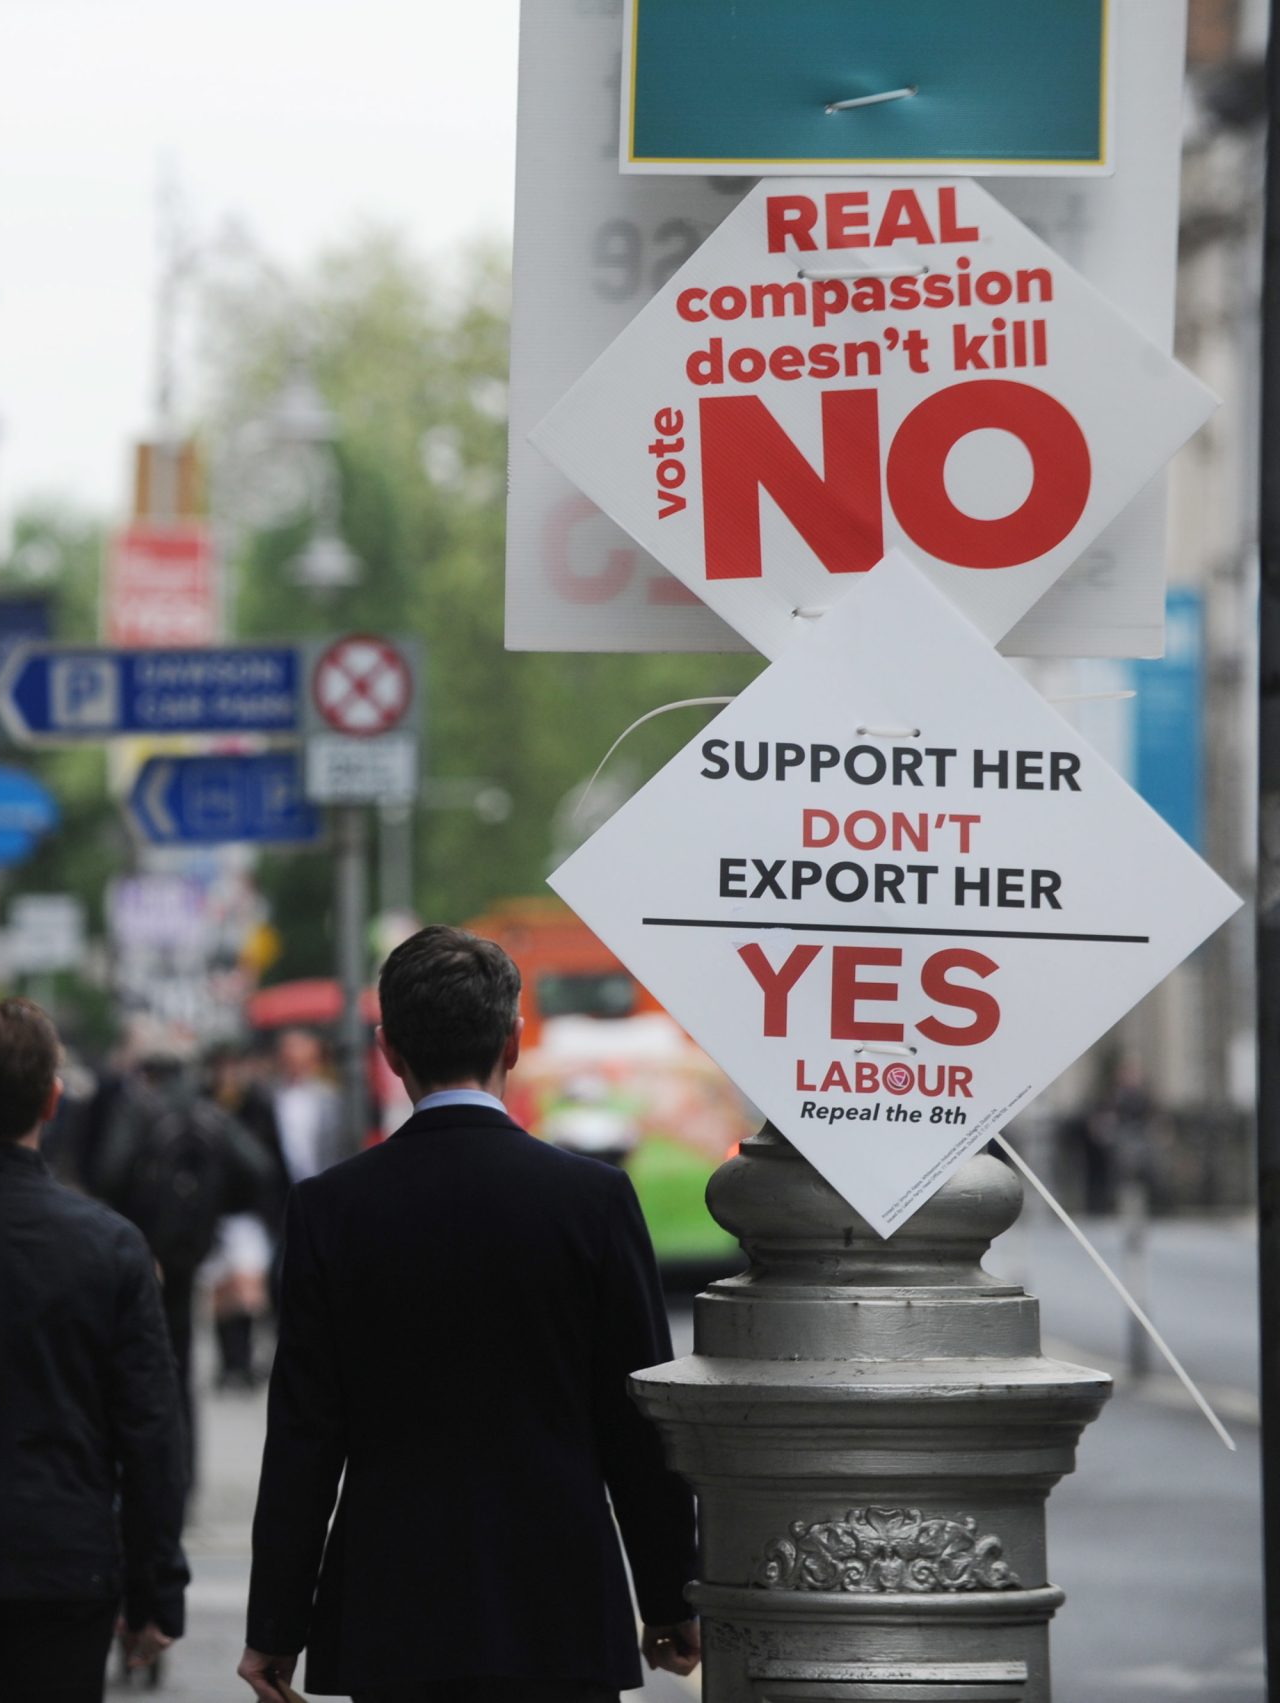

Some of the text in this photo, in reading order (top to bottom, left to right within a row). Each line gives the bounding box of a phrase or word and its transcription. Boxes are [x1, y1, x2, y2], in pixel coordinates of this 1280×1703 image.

[766, 186, 981, 254] REAL
[675, 256, 1054, 328] compassion
[685, 318, 1049, 387] doesn’t kill
[647, 406, 688, 520] vote
[698, 378, 1093, 582] NO
[700, 738, 1083, 793] SUPPORT HER
[801, 808, 982, 855] DON’T
[718, 857, 1064, 911] EXPORT HER
[737, 943, 1002, 1048] YES
[795, 1058, 974, 1099] LABOUR
[799, 1101, 968, 1126] Repeal the 8th
